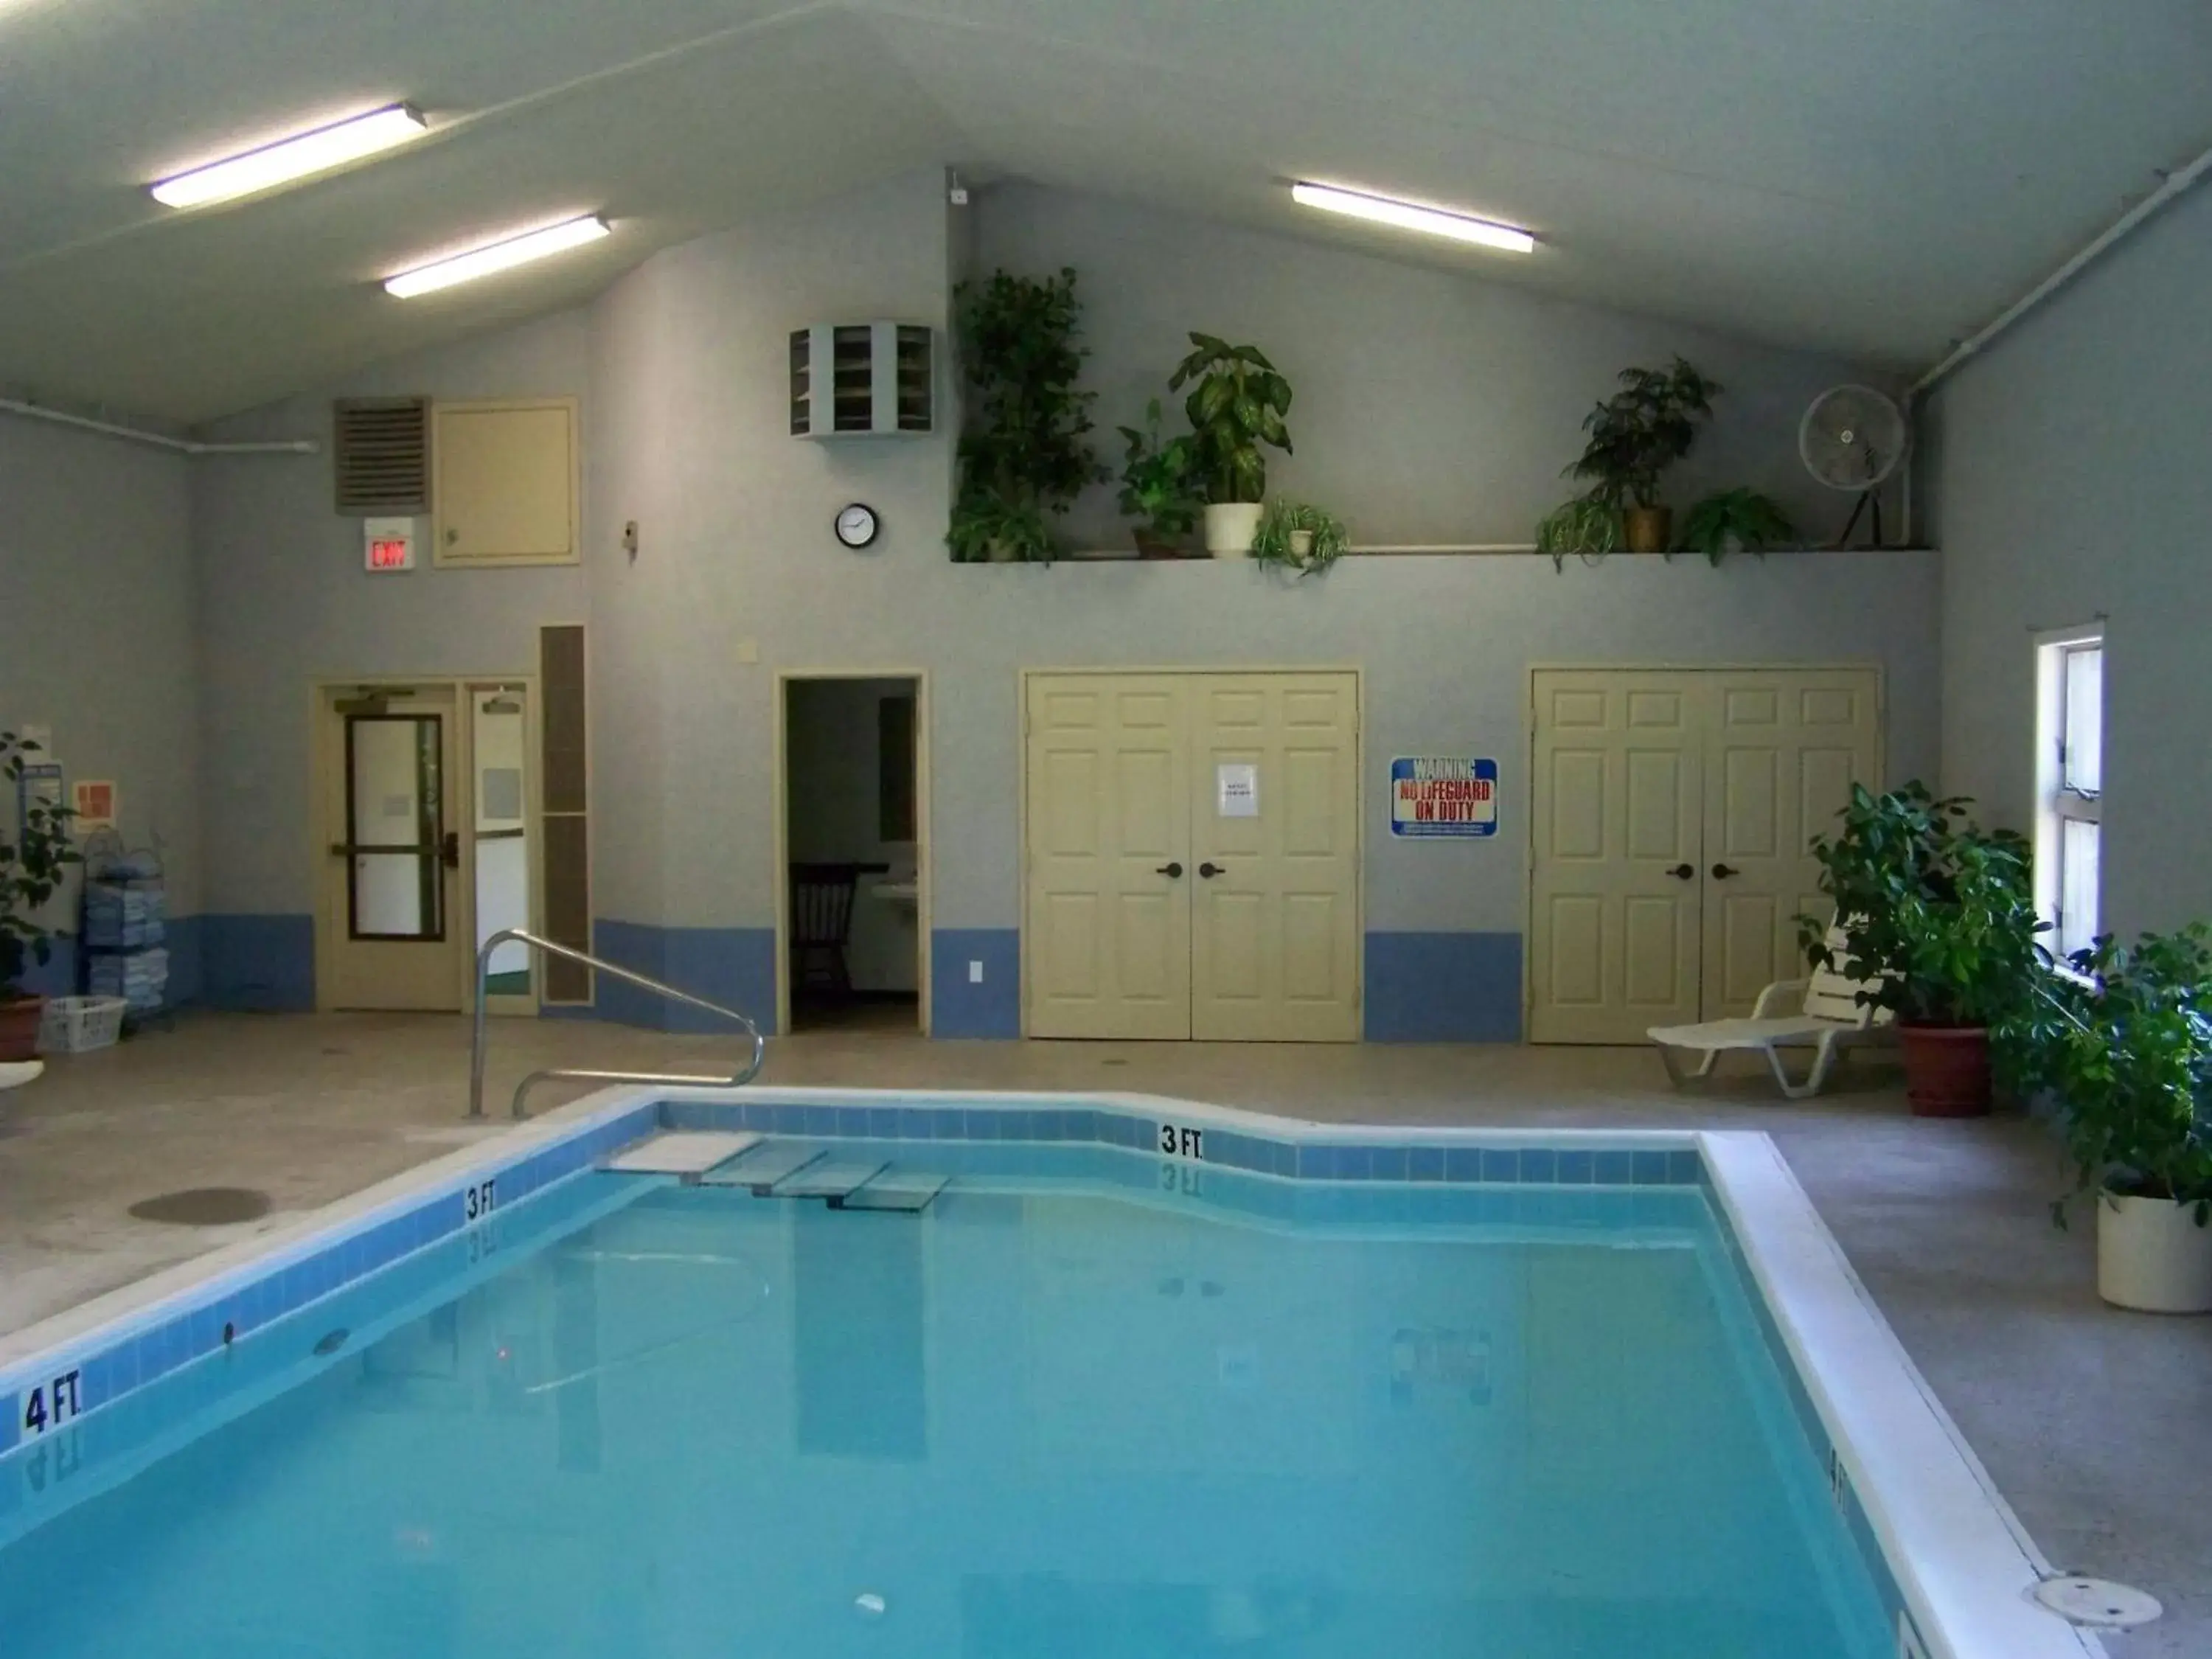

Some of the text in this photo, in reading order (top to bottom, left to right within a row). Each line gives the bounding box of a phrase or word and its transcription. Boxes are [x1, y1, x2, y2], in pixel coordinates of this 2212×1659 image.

[1400, 781, 1489, 801] NO LIFEGUARD
[1416, 801, 1474, 820] ON DUTY
[1162, 1125, 1176, 1154] 3
[467, 1180, 495, 1220] 3 FT
[26, 1386, 47, 1433] 4
